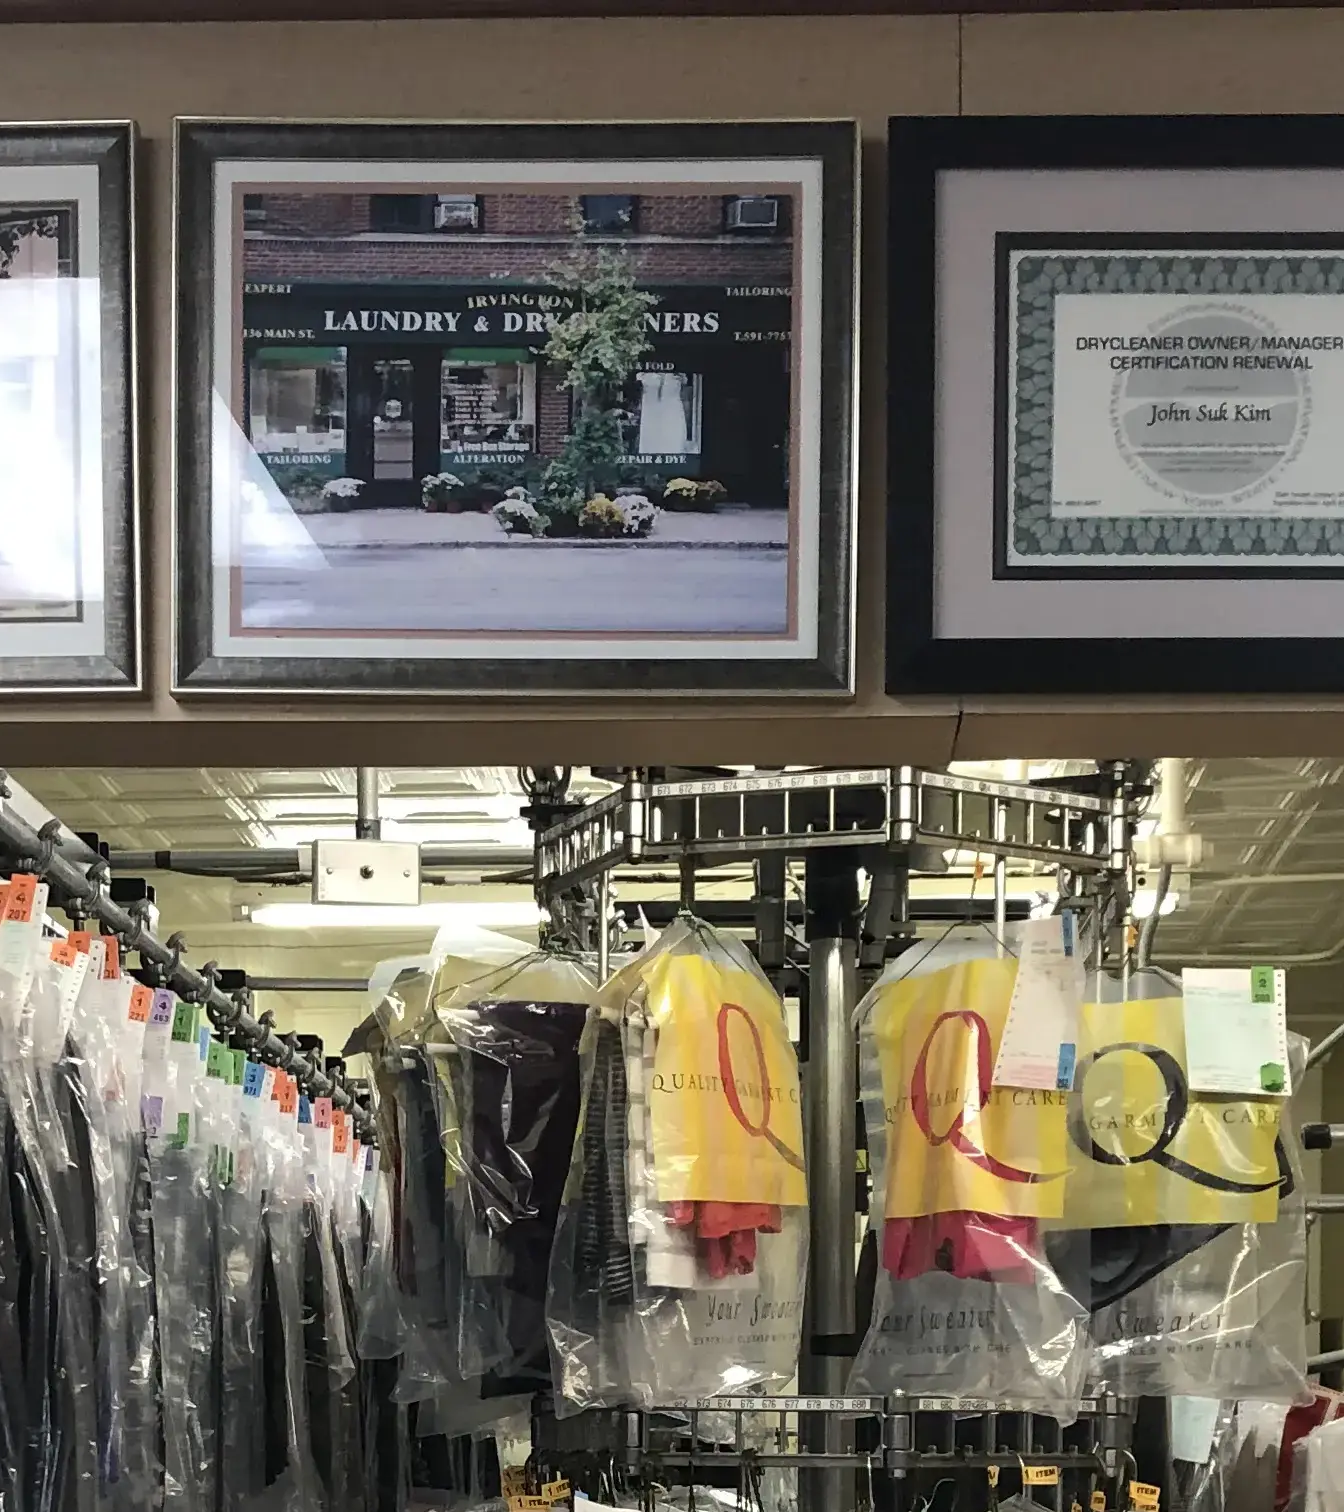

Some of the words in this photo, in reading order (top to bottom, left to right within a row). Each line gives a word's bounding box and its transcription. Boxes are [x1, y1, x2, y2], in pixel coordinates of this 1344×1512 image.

[245, 284, 292, 294] EXPERT
[324, 311, 461, 332] LAUNDRY
[473, 316, 489, 332] &
[264, 329, 295, 339] MAIN
[1076, 336, 1183, 351] DRYCLEANER
[1110, 355, 1229, 370] CERTIFICATION
[1232, 355, 1313, 370] RENEWAL
[1146, 403, 1191, 426] John
[1196, 403, 1228, 421] Suk
[1233, 404, 1271, 422] Kim
[267, 454, 331, 465] TAILORING
[453, 454, 525, 464] ALTERATION
[911, 1010, 1075, 1184] Q
[1012, 1089, 1068, 1106] CARE
[1064, 1042, 1288, 1193] Q
[1222, 1106, 1282, 1124] CARE
[1036, 1468, 1056, 1479] ITEM
[1136, 1486, 1157, 1496] ITEM
